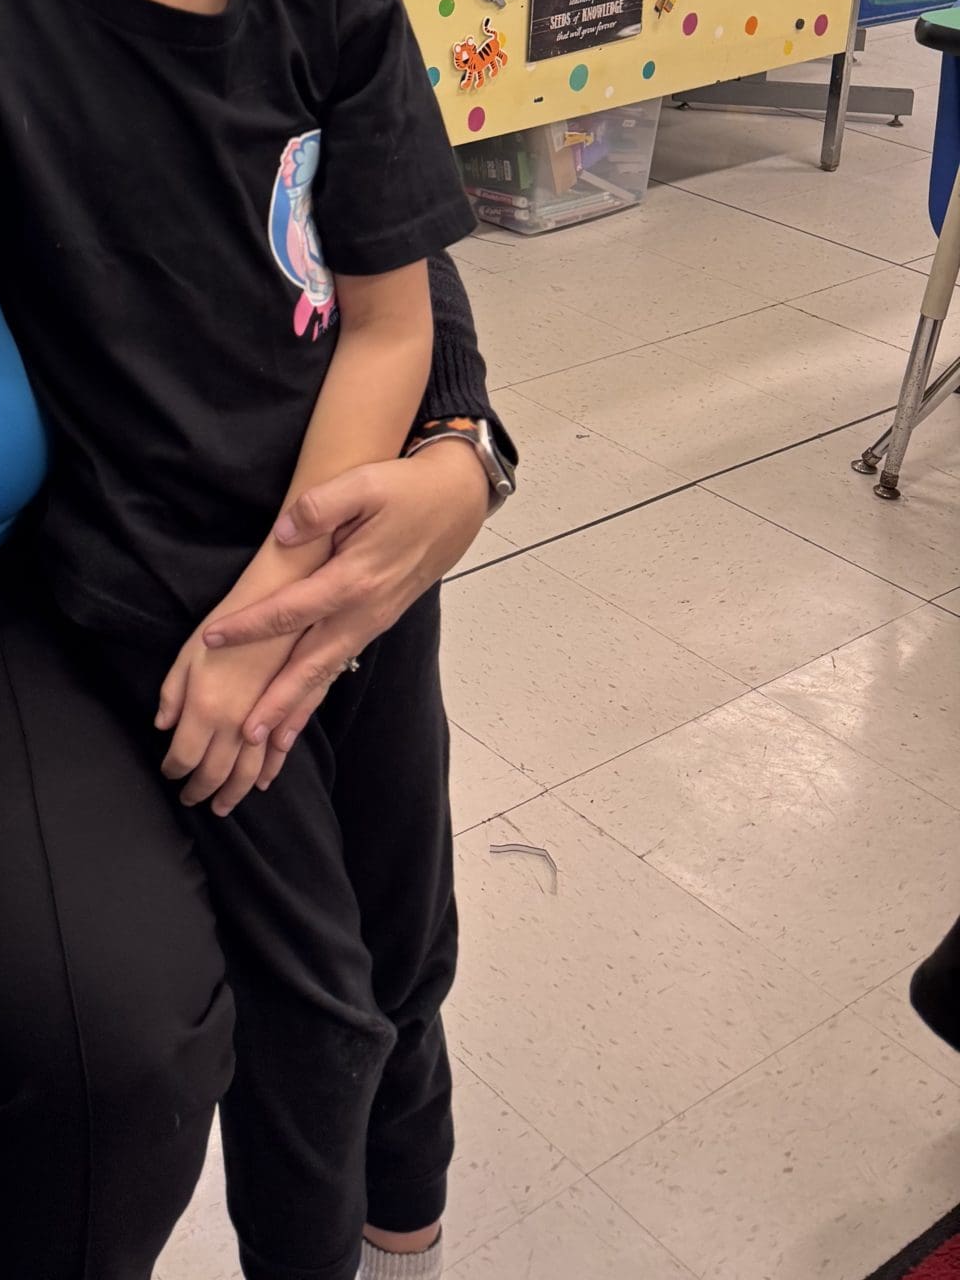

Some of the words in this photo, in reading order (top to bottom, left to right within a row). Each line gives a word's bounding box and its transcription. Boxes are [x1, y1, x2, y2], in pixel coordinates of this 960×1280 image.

[550, 12, 571, 30] SEEDS
[582, 0, 624, 22] KNOWLEDGE
[556, 31, 569, 42] that
[595, 21, 618, 35] forever
